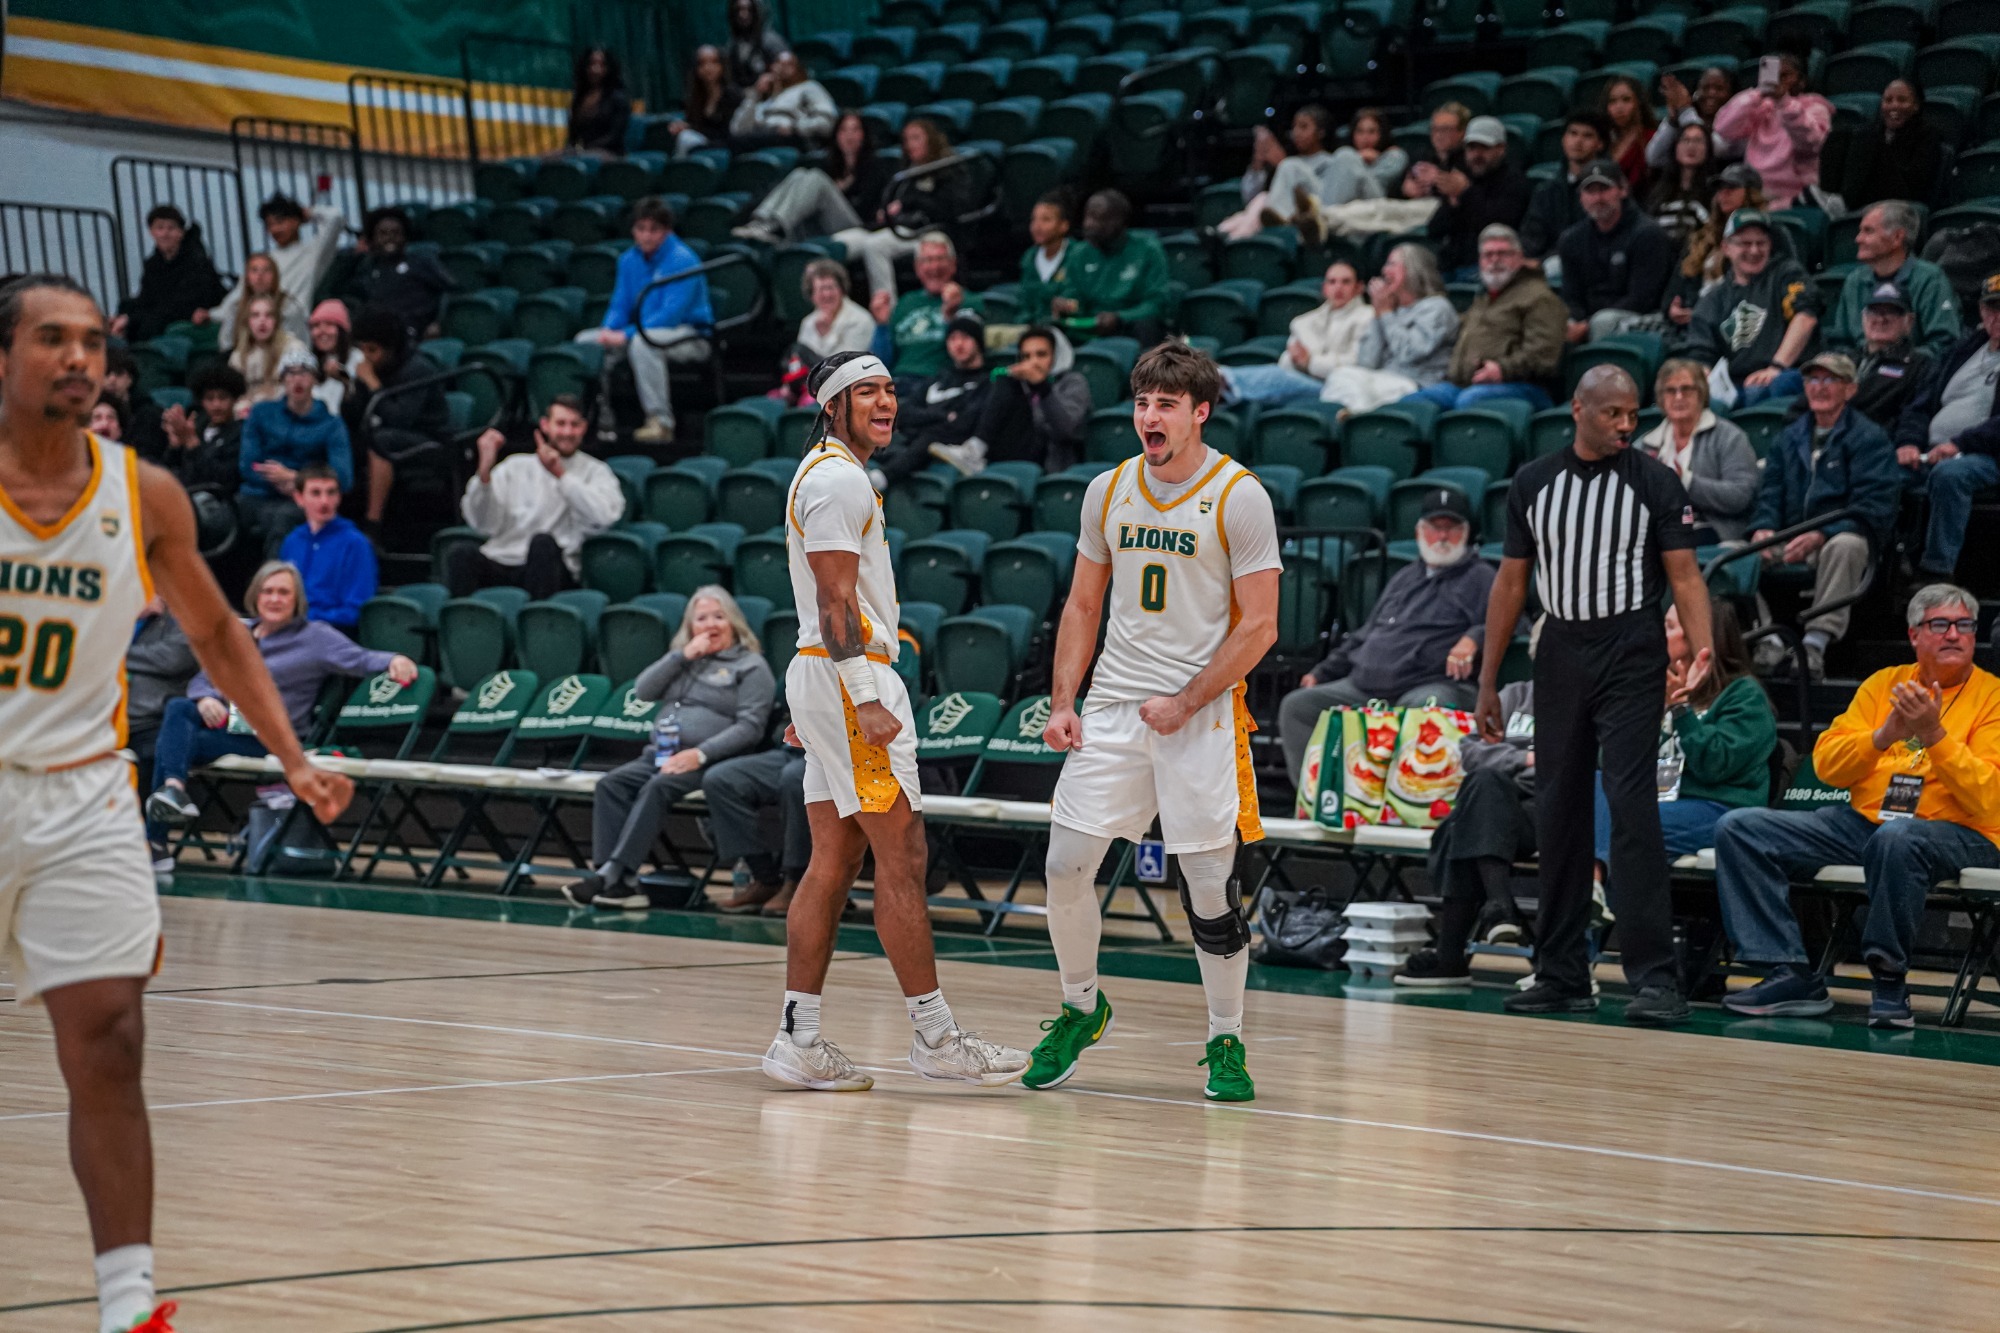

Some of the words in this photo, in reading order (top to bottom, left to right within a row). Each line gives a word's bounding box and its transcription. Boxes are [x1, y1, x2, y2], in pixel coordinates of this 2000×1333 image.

[1118, 523, 1199, 559] LIONS
[0, 558, 106, 606] IONS
[1140, 563, 1168, 613] 0
[0, 614, 77, 693] 20
[1783, 788, 1812, 801] 1889
[1812, 788, 1852, 803] Society
